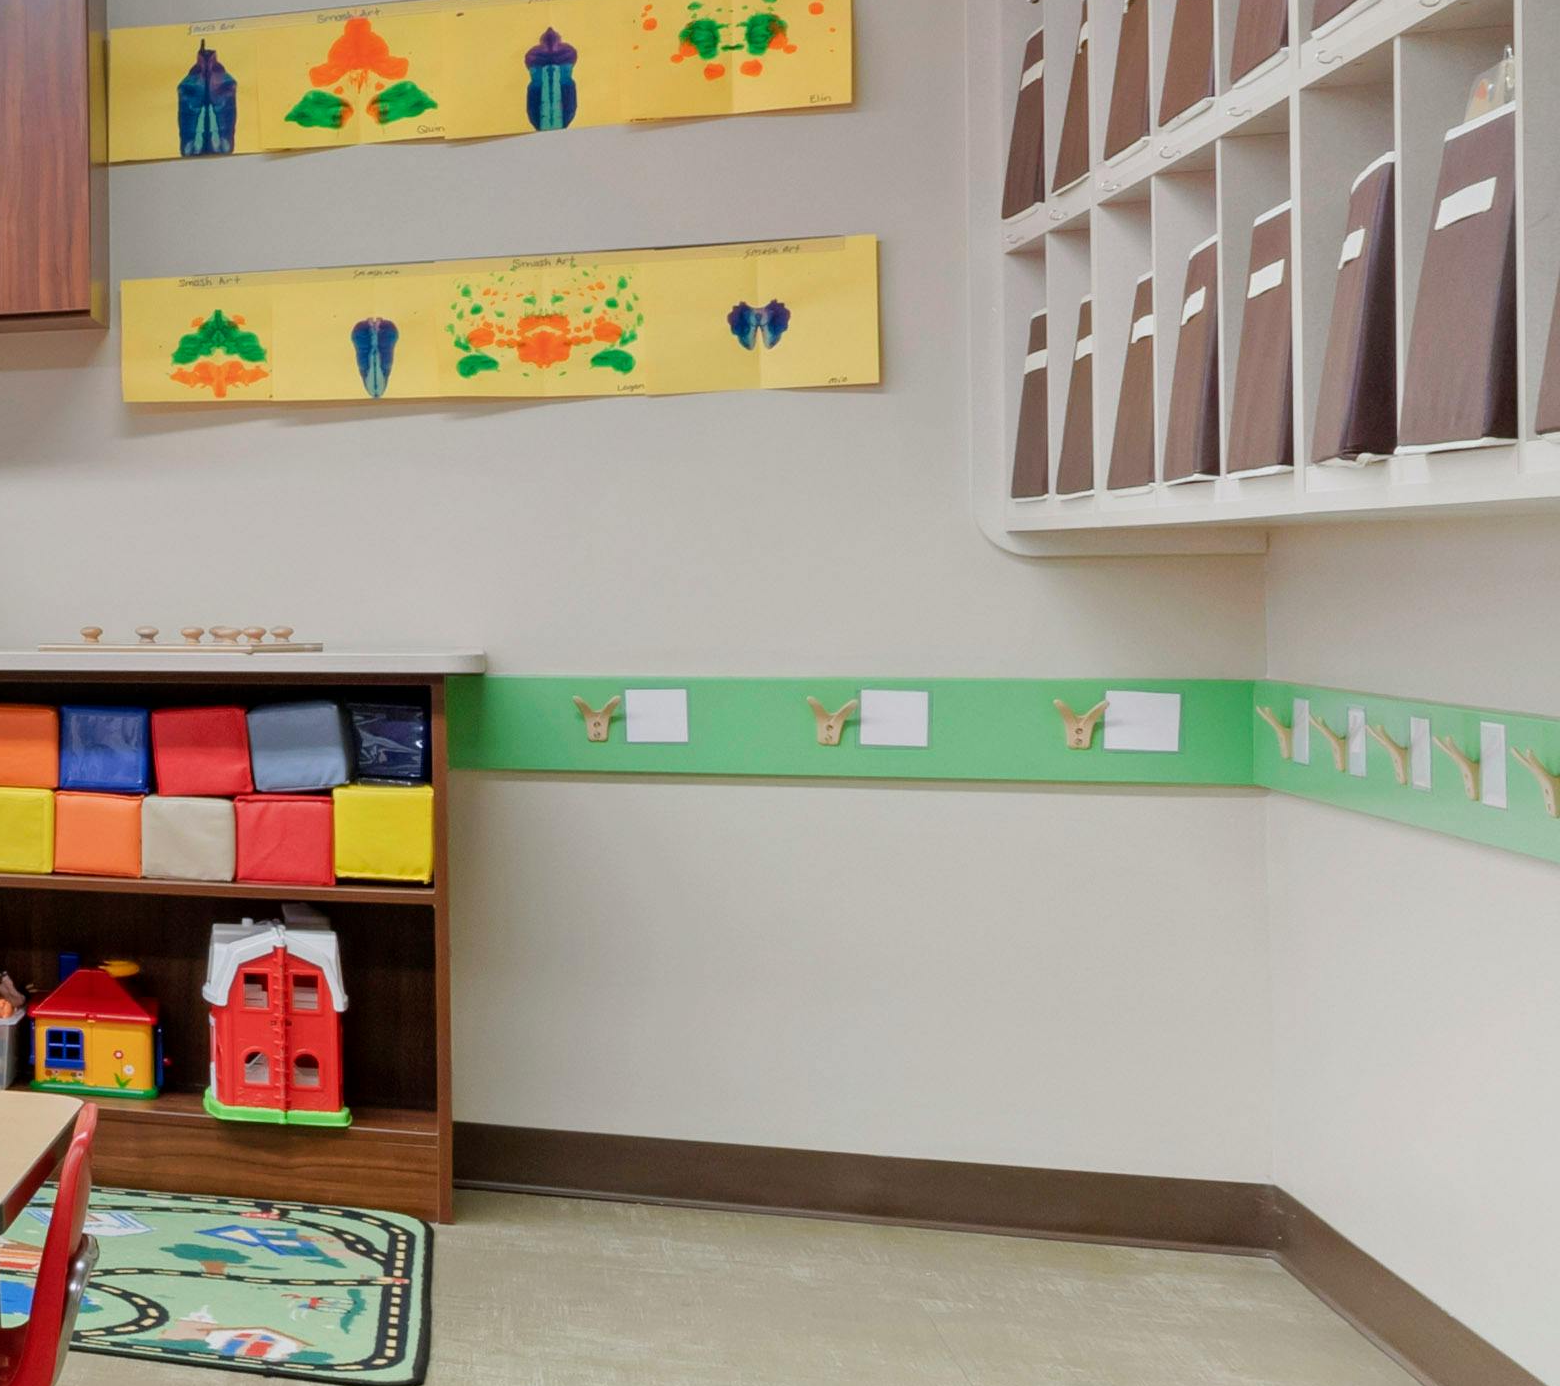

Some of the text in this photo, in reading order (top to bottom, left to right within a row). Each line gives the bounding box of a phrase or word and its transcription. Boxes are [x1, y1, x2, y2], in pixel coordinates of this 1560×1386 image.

[359, 8, 383, 18] Art
[743, 247, 779, 259] Smash
[513, 255, 577, 271] Smash Art
[179, 276, 242, 288] Smash Art
